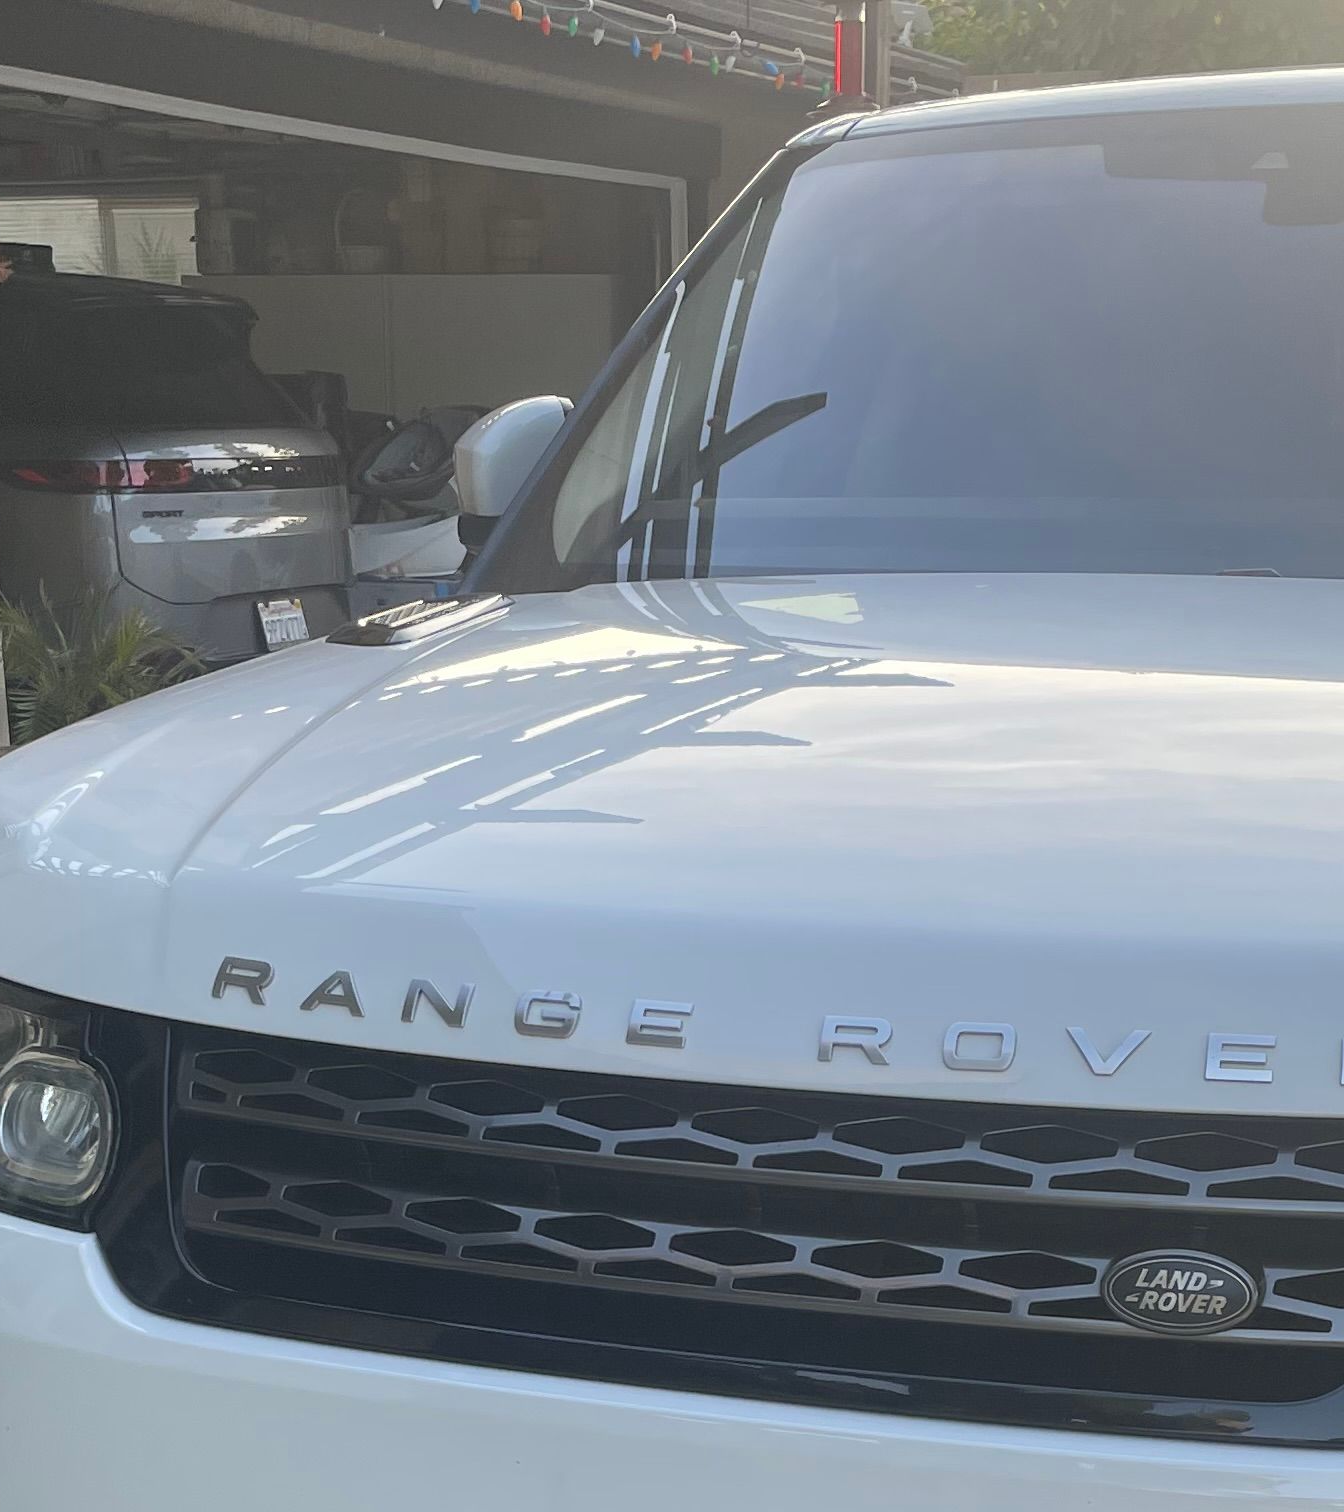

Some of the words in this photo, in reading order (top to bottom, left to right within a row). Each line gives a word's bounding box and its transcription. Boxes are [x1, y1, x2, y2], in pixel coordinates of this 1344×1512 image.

[211, 955, 695, 1049] RANGE
[1135, 1268, 1208, 1292] LAND
[1138, 1290, 1228, 1316] ROVER
